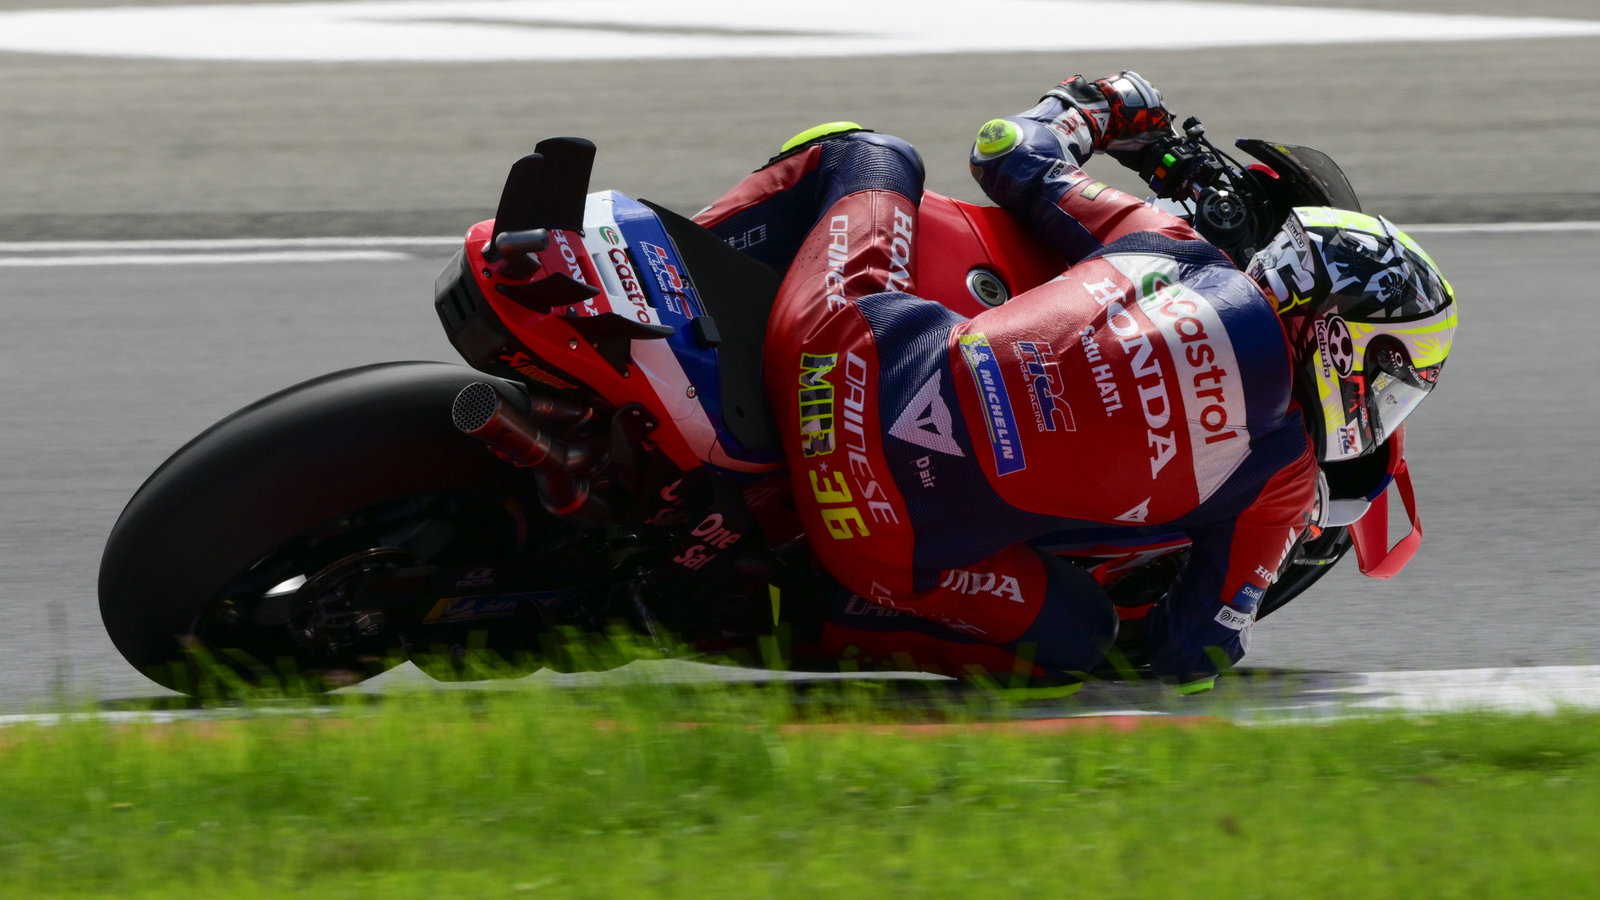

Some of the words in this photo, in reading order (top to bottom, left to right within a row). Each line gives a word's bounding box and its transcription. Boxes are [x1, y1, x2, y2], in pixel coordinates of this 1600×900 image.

[1017, 341, 1077, 433] HRC
[1078, 324, 1103, 364] Satu
[1091, 358, 1124, 418] HATI.
[1082, 276, 1178, 480] HONDA
[1158, 296, 1239, 445] Castrol
[1315, 320, 1331, 379] Kabuto
[799, 352, 838, 459] MIR
[844, 351, 900, 525] DAINESE
[979, 368, 1014, 460] MICHELIN
[1026, 382, 1044, 433] RACING
[691, 513, 742, 549] One
[808, 469, 871, 540] 36
